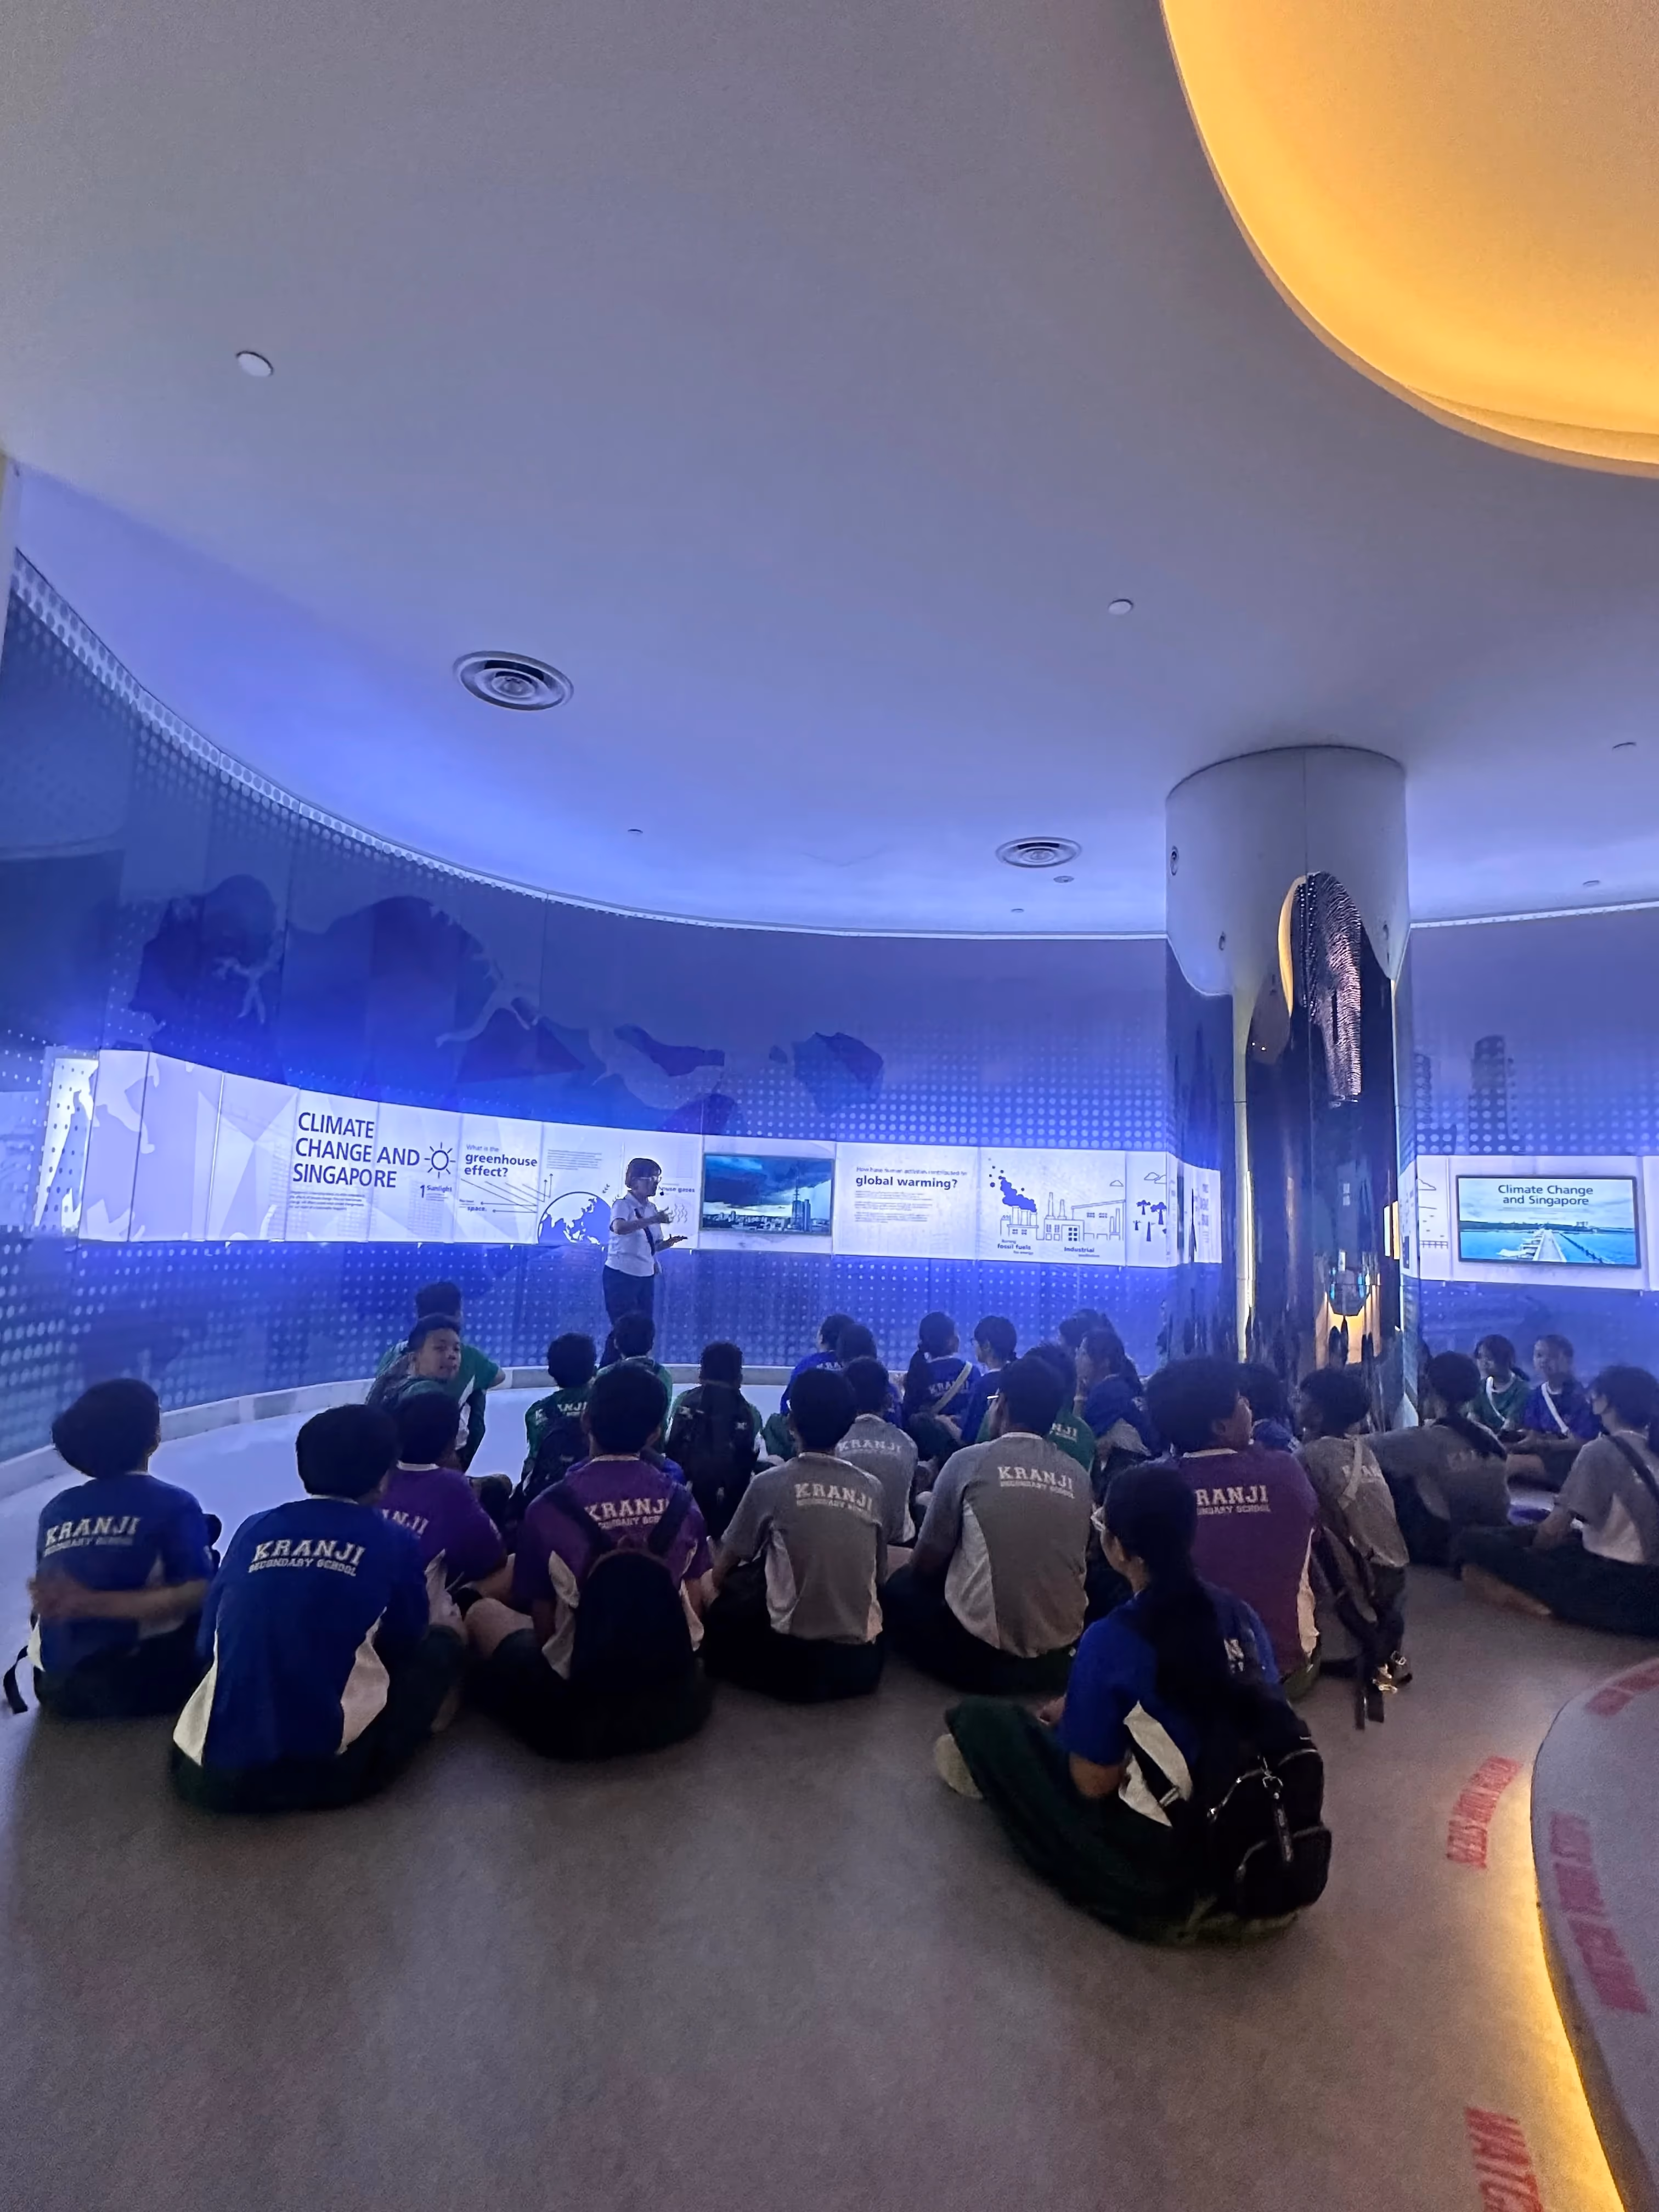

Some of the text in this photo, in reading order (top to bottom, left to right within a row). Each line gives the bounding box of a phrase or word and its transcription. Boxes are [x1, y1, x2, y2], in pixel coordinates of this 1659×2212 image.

[298, 1112, 375, 1138] CLIMATE
[296, 1137, 420, 1166] CHANGE AND
[465, 1154, 538, 1166] greenhouse
[293, 1163, 397, 1188] SINGAPORE
[464, 1165, 508, 1177] effect?
[420, 1185, 425, 1198] 1
[856, 1175, 958, 1190] global warming?
[1498, 1184, 1593, 1197] Climate Change
[1503, 1195, 1589, 1207] and Singapore
[837, 1440, 901, 1453] KRANJI
[997, 1466, 1073, 1490] KRANJI
[794, 1483, 872, 1511] KRANJI
[1195, 1485, 1269, 1506] RANJI
[46, 1516, 140, 1548] KRANJI
[251, 1539, 365, 1566] KRANJI
[248, 1558, 357, 1577] SECONDARY SCHOOL
